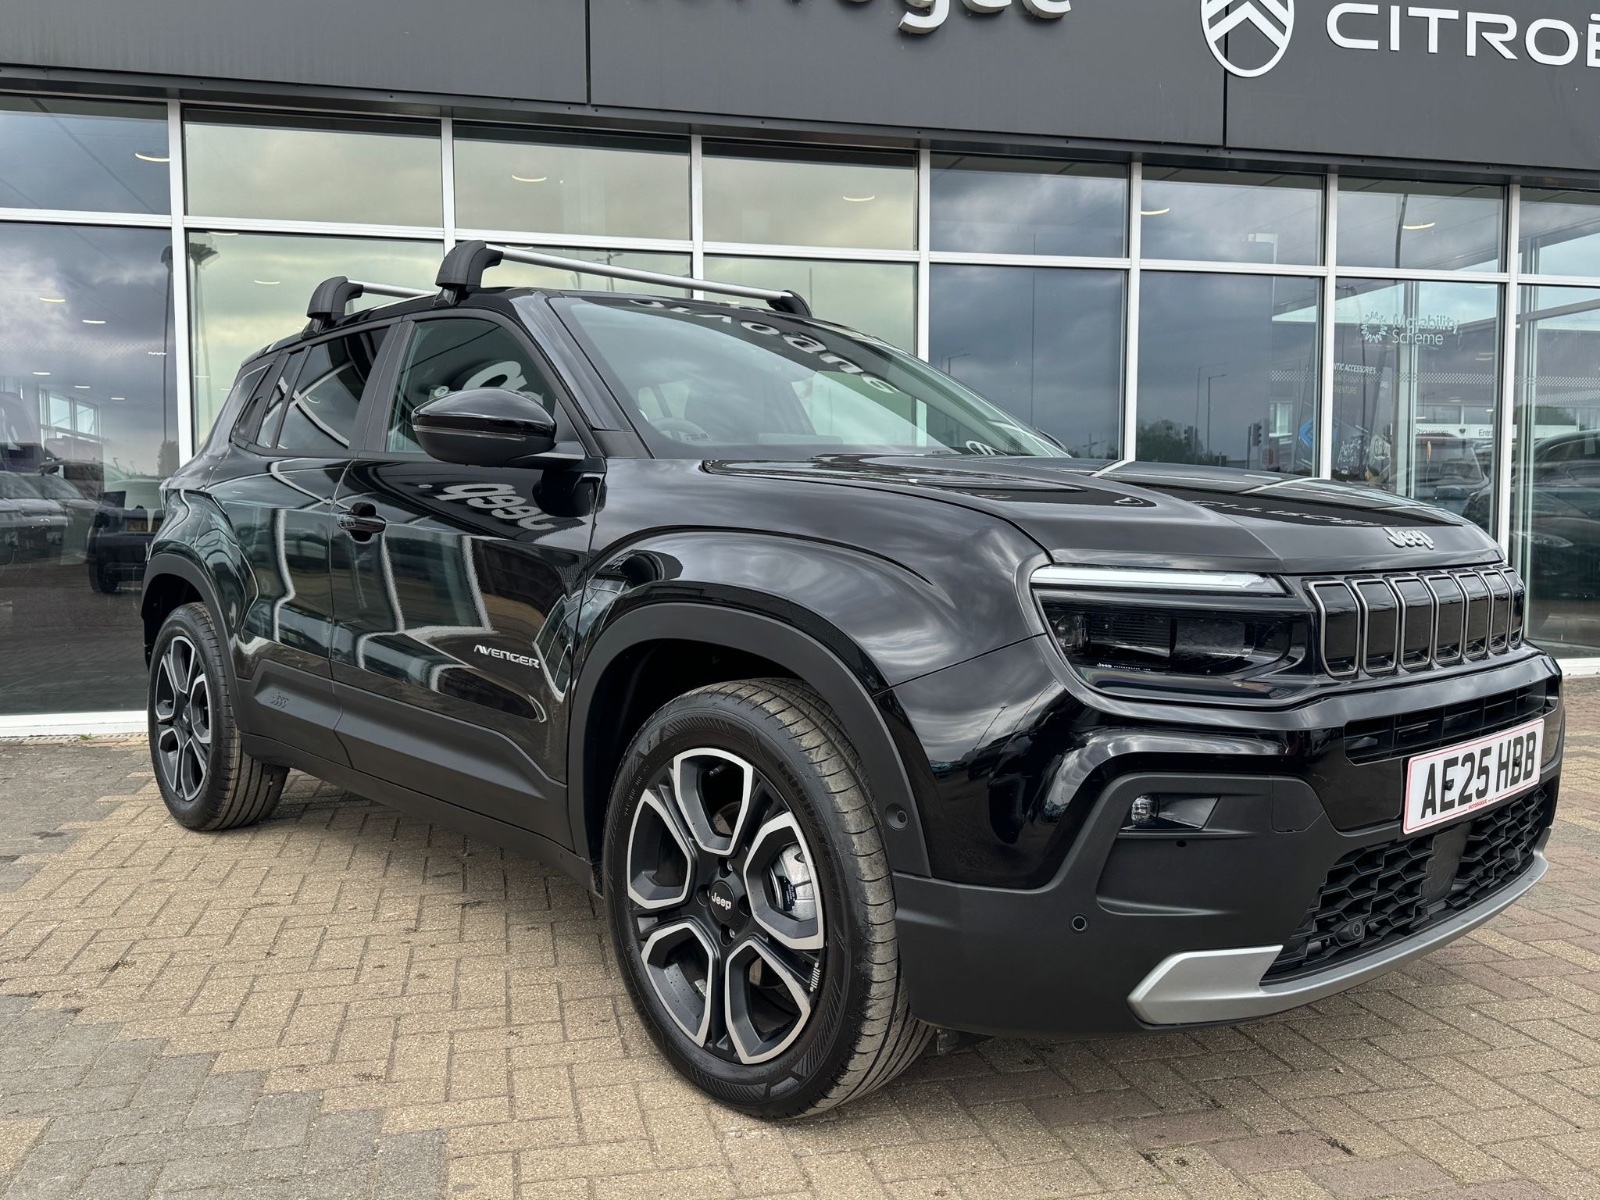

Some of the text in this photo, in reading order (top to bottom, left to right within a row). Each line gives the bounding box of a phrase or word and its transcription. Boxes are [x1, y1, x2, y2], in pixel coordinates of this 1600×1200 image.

[1391, 329, 1444, 345] Scheme
[1382, 526, 1435, 550] Jeep
[473, 644, 540, 669] AVENGER
[1420, 731, 1537, 820] AE25 HBB
[711, 892, 732, 911] Jeep
